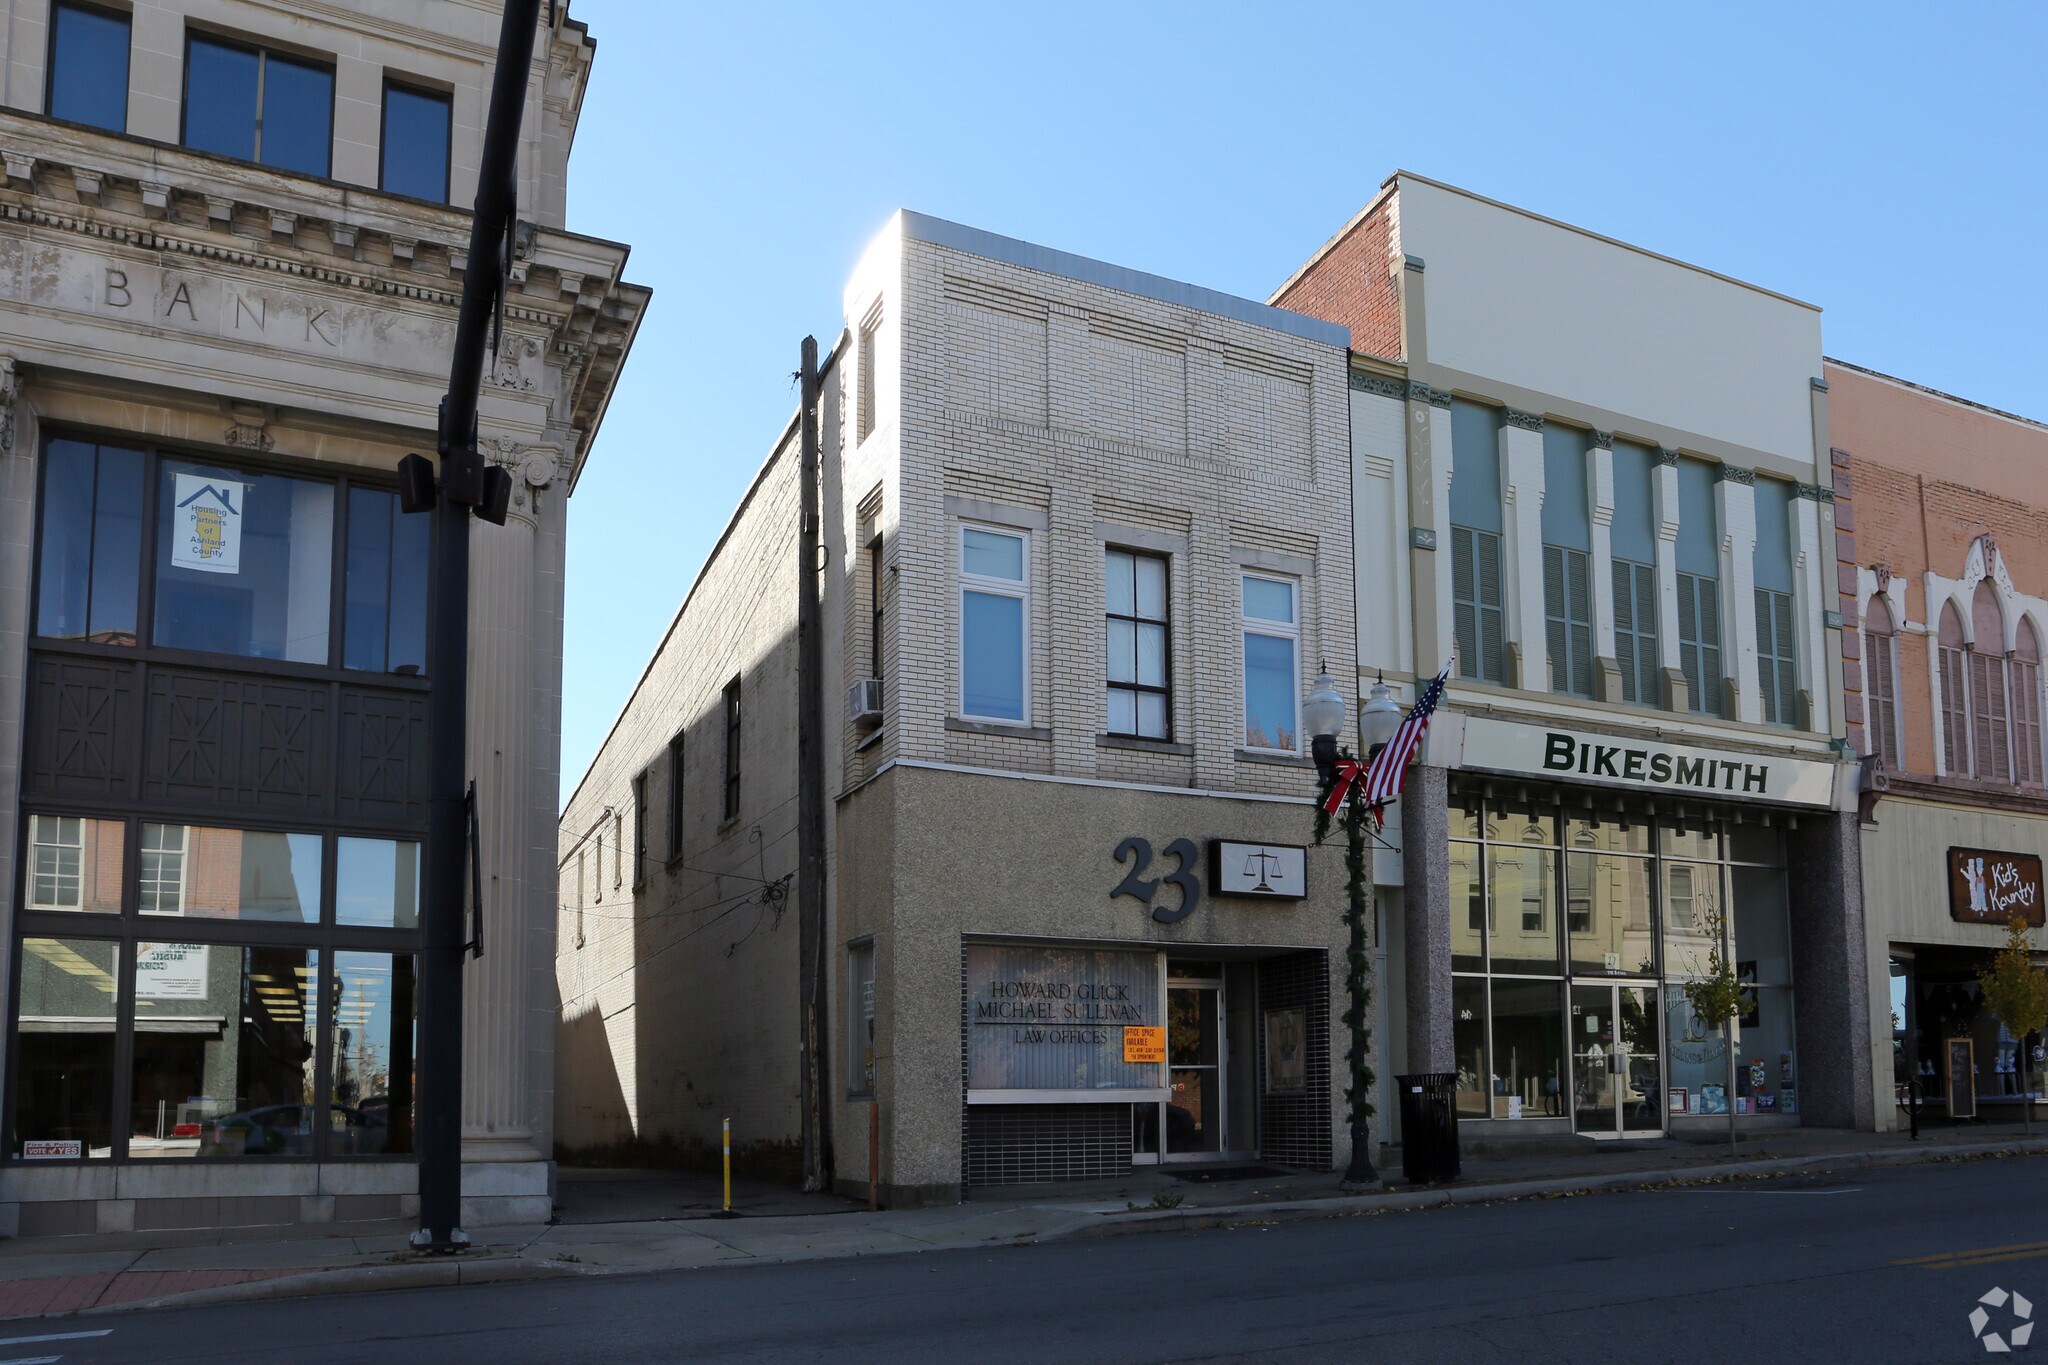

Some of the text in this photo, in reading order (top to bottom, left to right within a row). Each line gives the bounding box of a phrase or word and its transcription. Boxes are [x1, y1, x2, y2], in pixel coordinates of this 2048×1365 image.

[103, 267, 337, 347] BANK
[191, 504, 227, 518] Housing
[190, 514, 227, 527] Partners
[204, 527, 213, 535] of
[190, 536, 226, 547] Ashland
[192, 546, 223, 558] County
[1543, 732, 1769, 794] BIKESMITH
[1110, 837, 1200, 924] 23
[1991, 861, 2019, 888] Kid's
[992, 981, 1129, 1001] HOWARD GLICK
[977, 1001, 1142, 1021] MICHAEL SULLIVAN
[1015, 1030, 1108, 1045] LAW OFFICES
[1125, 1027, 1155, 1037] OFFICE SPACE
[28, 1147, 78, 1155] VOTE YES
